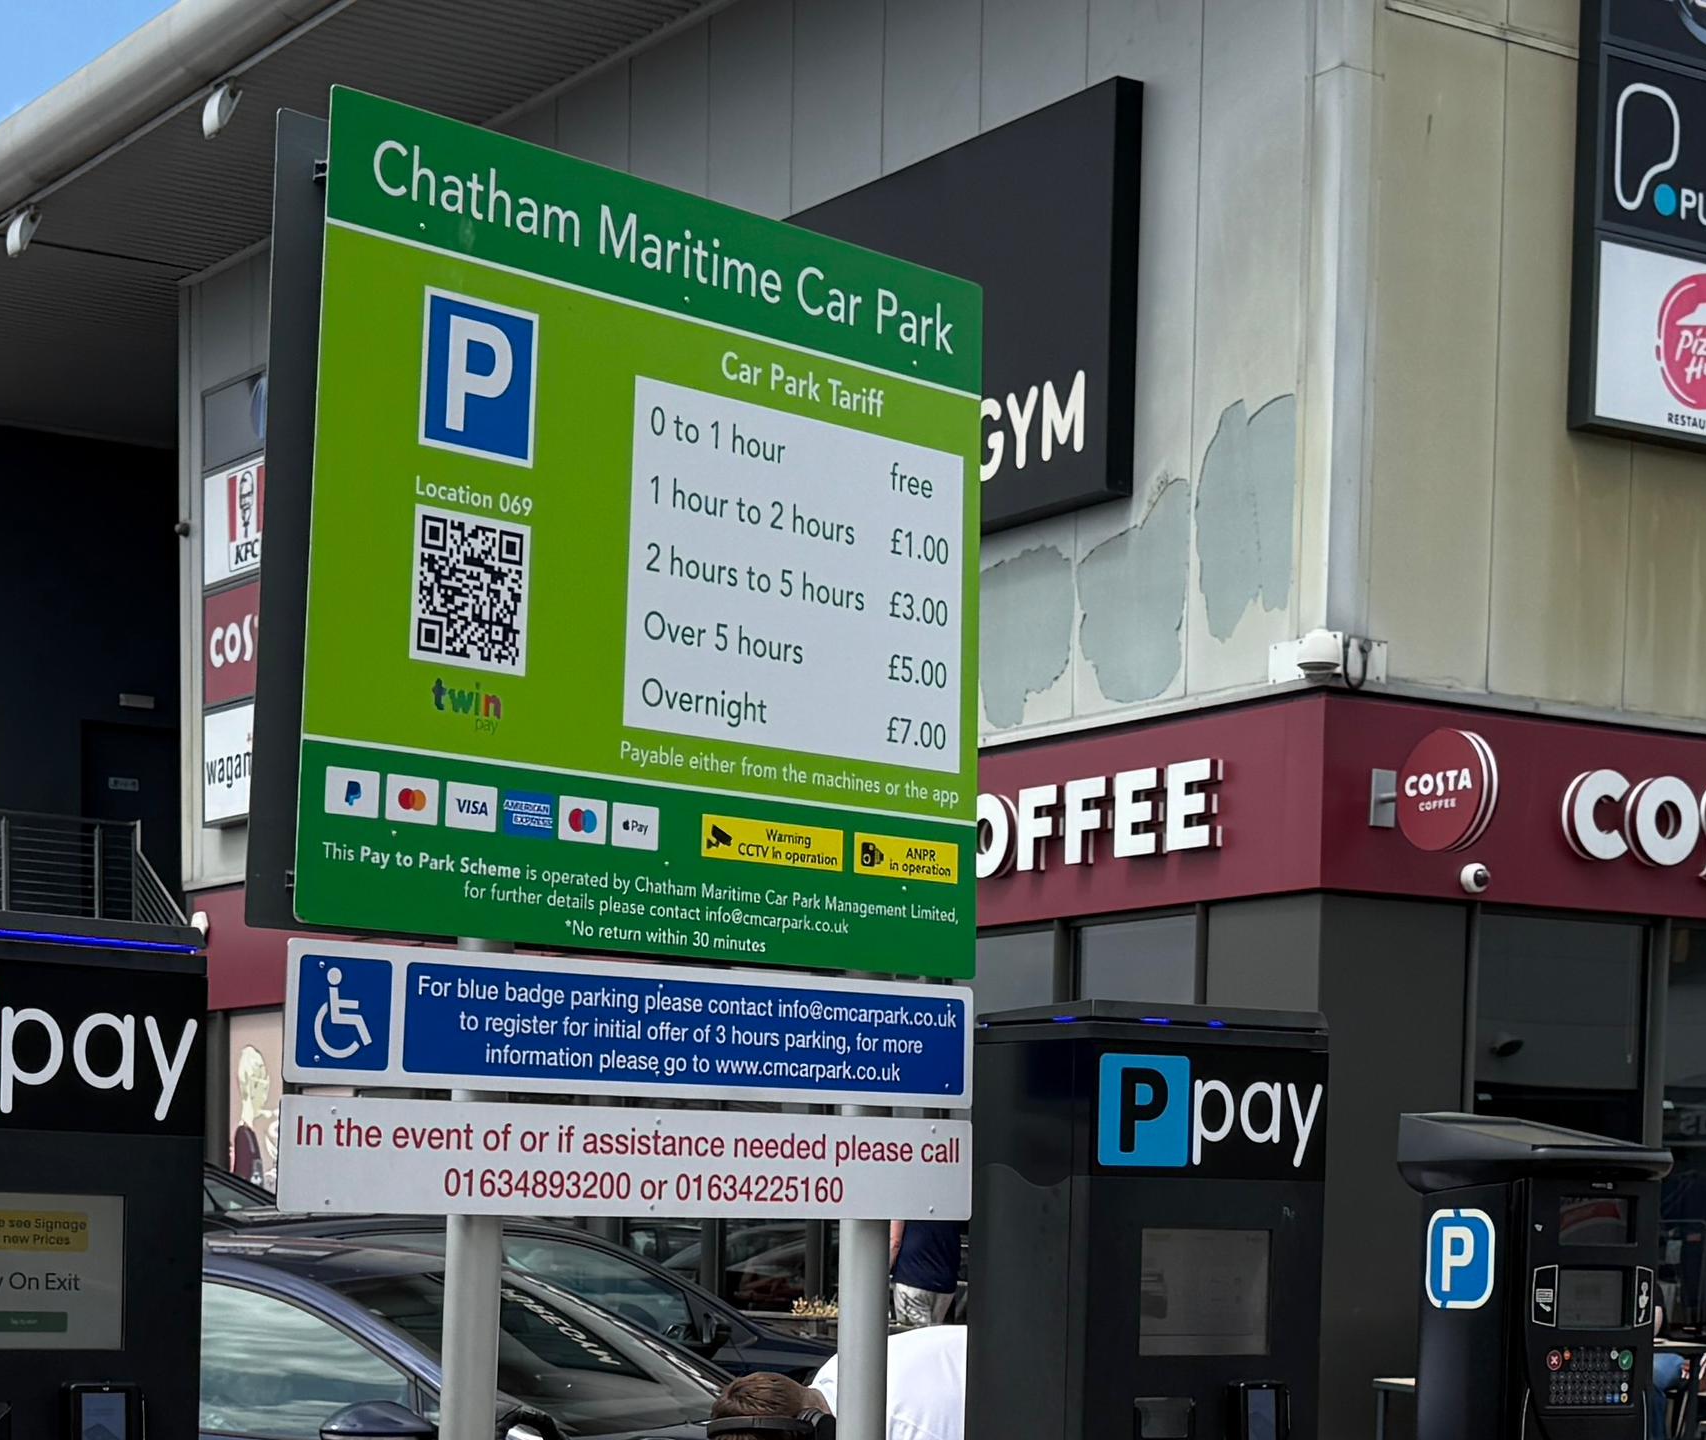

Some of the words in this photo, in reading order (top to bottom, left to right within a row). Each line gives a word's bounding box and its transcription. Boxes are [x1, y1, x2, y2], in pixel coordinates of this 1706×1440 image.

[373, 140, 580, 247] Chatham
[599, 204, 782, 304] Maritime
[797, 266, 862, 326] Car
[876, 287, 954, 355] Park
[445, 314, 513, 432] P
[721, 351, 763, 386] Car
[770, 362, 821, 402] Park
[827, 378, 885, 418] Tariff
[650, 406, 666, 437] 0
[673, 415, 700, 444] to
[710, 420, 719, 450] 1
[732, 423, 786, 464] hour
[890, 461, 933, 499] free
[415, 475, 493, 509] Location
[499, 492, 533, 517] 069
[650, 475, 660, 505] 1
[672, 477, 729, 518] hour
[736, 497, 761, 525] to
[770, 500, 784, 531] 2
[792, 503, 855, 546] hours
[890, 527, 949, 565] £1.00
[234, 538, 260, 565] KFC
[646, 542, 661, 573] 2
[670, 544, 738, 588] hours
[746, 566, 771, 594] to
[779, 568, 793, 598] 5
[802, 571, 865, 612] hours
[889, 591, 948, 627] £3.00
[210, 613, 258, 668] COS
[644, 610, 707, 648] Over
[714, 622, 728, 652] 5
[738, 624, 803, 665] hours
[887, 653, 947, 689] £5.00
[432, 677, 503, 720] twin
[642, 677, 767, 728] Overnight
[886, 716, 946, 751] £7.00
[620, 740, 684, 768] Payable
[689, 751, 736, 773] either
[741, 756, 777, 780] from
[782, 763, 808, 784] the
[812, 770, 881, 794] machines
[885, 782, 901, 796] or
[904, 780, 929, 800] the
[932, 788, 960, 809] app
[1404, 767, 1473, 798] COSTA
[456, 798, 488, 817] VISA
[503, 799, 550, 815] AMERICAN
[976, 758, 1224, 879] OFFEE
[1418, 796, 1458, 813] COFFEE
[631, 819, 649, 836] Pay
[765, 828, 813, 850] Warning
[737, 842, 769, 858] CCTV
[771, 846, 782, 860] in
[785, 851, 838, 866] operation
[889, 858, 899, 872] in
[901, 863, 951, 877] operation
[905, 847, 938, 862] ANPR
[322, 841, 355, 862] This
[360, 845, 391, 869] Pay
[395, 851, 413, 868] to
[418, 852, 455, 873] Park
[459, 856, 521, 879] Scheme
[525, 863, 538, 881] is
[541, 870, 609, 888] operated
[612, 872, 631, 895] by
[634, 875, 697, 898] Chatham
[701, 882, 762, 904] Maritime
[764, 889, 788, 906] Car
[792, 891, 821, 910] Park
[824, 895, 907, 919] Management
[911, 903, 959, 925] Limited,
[464, 880, 487, 899] for
[490, 882, 543, 905] further
[546, 889, 595, 911] details
[599, 895, 645, 916] please
[649, 905, 701, 921] contact
[705, 905, 849, 934] info@cmcarpark.co.uk
[598, 926, 642, 941] return
[645, 927, 688, 946] within
[692, 930, 710, 948] 30
[713, 934, 766, 953] minutes
[418, 975, 452, 997] For
[457, 977, 499, 1001] blue
[504, 981, 565, 1009] badge
[570, 987, 639, 1014] parking
[644, 991, 703, 1015] please
[708, 997, 773, 1017] contact
[778, 998, 957, 1028] info@cmcarpark.co.uk
[459, 1011, 479, 1031] to
[485, 1013, 559, 1038] register
[562, 1016, 590, 1037] for
[594, 1017, 642, 1040] initial
[647, 1021, 689, 1042] offer
[692, 1023, 711, 1044] of
[715, 1024, 726, 1044] 3
[731, 1025, 780, 1047] hours
[784, 1030, 851, 1055] parking,
[856, 1032, 879, 1052] for
[883, 1038, 923, 1054] more
[0, 1007, 198, 1122] pay
[485, 1042, 593, 1068] information
[599, 1049, 660, 1076] please
[663, 1056, 687, 1076] go
[692, 1054, 710, 1073] to
[715, 1059, 901, 1083] www.cmcarpark.co.uk
[1119, 1067, 1169, 1154] P
[1192, 1079, 1324, 1168] pay
[297, 1115, 323, 1146] In
[333, 1117, 382, 1148] the
[392, 1123, 474, 1151] event
[482, 1122, 512, 1152] of
[520, 1130, 550, 1153] or
[558, 1125, 575, 1153] if
[582, 1127, 725, 1158] assistance
[733, 1132, 827, 1160] needed
[835, 1134, 914, 1168] please
[920, 1137, 960, 1164] call
[444, 1167, 631, 1200] 01634893200
[640, 1179, 668, 1201] or
[675, 1173, 843, 1204] 01634225160
[3, 1234, 30, 1245] new
[33, 1234, 71, 1246] Prices
[8, 1218, 32, 1230] see
[34, 1217, 88, 1233] Signage
[1440, 1225, 1476, 1293] P
[9, 1272, 39, 1291] On
[45, 1273, 81, 1292] Exit
